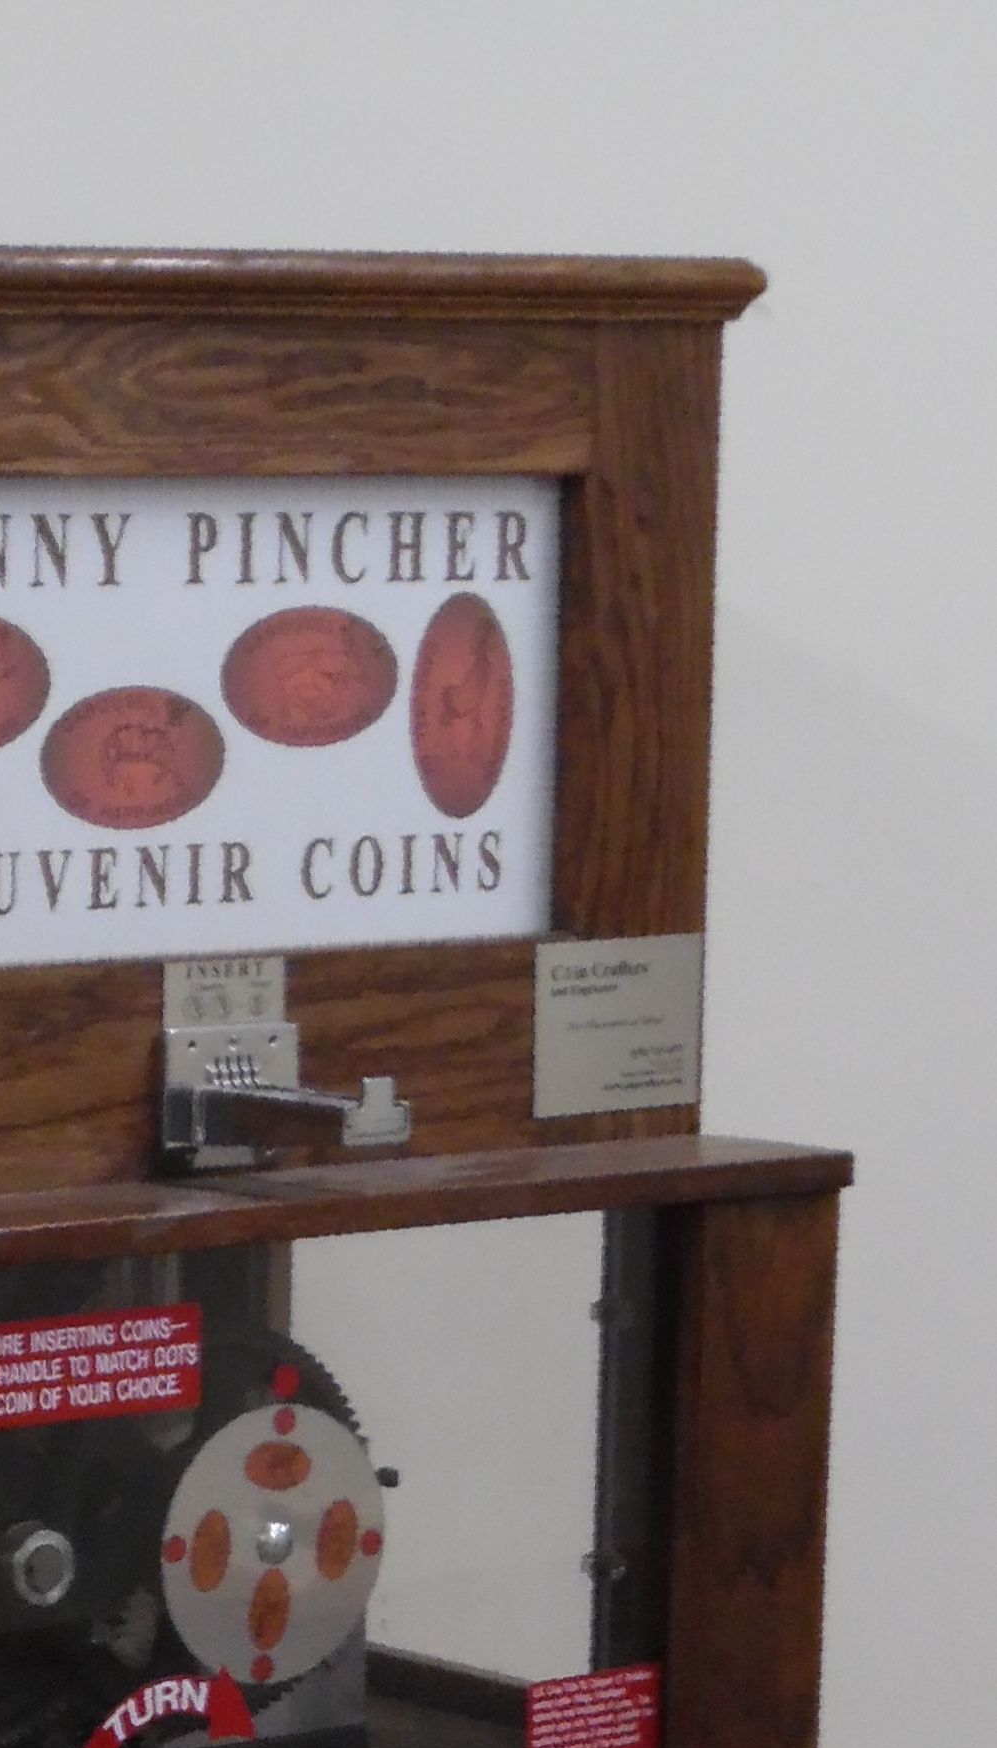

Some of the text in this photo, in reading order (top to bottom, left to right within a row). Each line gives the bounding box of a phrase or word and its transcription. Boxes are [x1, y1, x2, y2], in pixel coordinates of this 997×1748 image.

[186, 510, 532, 586] PINCHER
[301, 828, 504, 900] COINS
[186, 961, 262, 979] INSERT
[30, 1324, 114, 1351] INSERTING
[69, 1355, 91, 1377] TO
[95, 1349, 149, 1373] MATCH
[154, 1343, 199, 1366] DOTS
[39, 1387, 64, 1410] OF
[67, 1380, 112, 1406] YOUR
[103, 1679, 210, 1741] TURN
